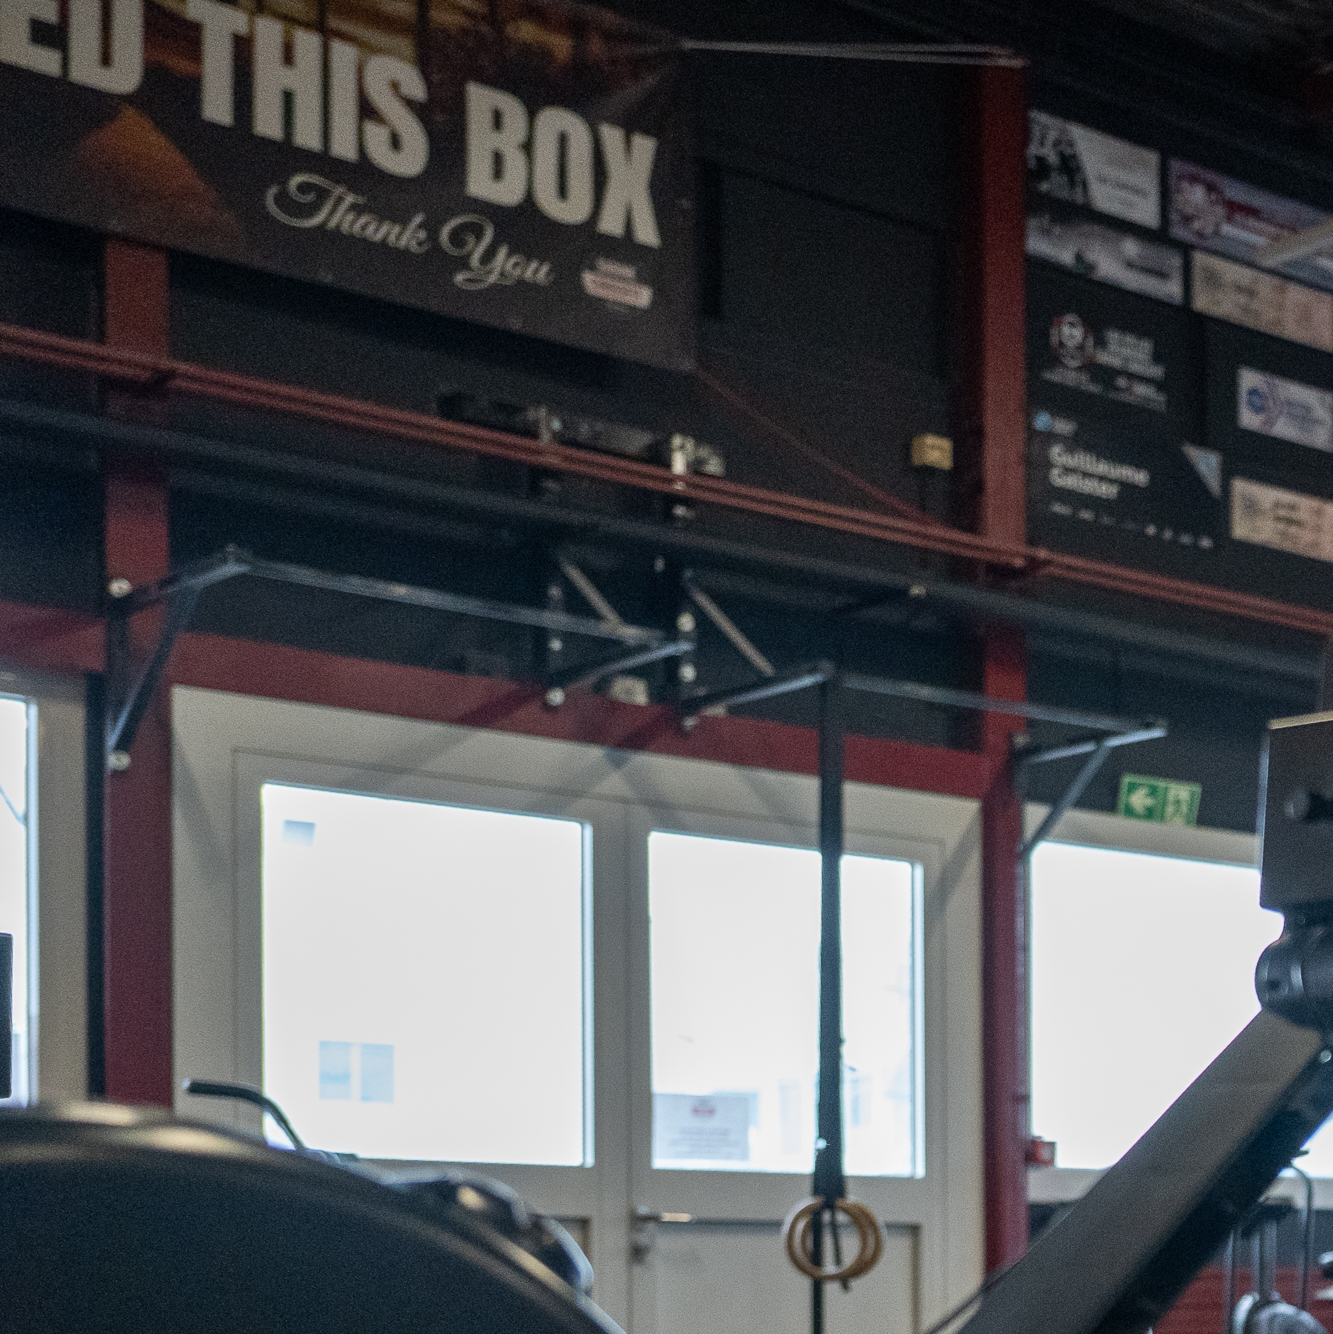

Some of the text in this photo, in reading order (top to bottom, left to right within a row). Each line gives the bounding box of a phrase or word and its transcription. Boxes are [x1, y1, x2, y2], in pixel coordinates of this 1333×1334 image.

[187, 0, 430, 178] THIS
[465, 80, 662, 249] BOX
[264, 172, 431, 255] Thank
[438, 213, 555, 291] You
